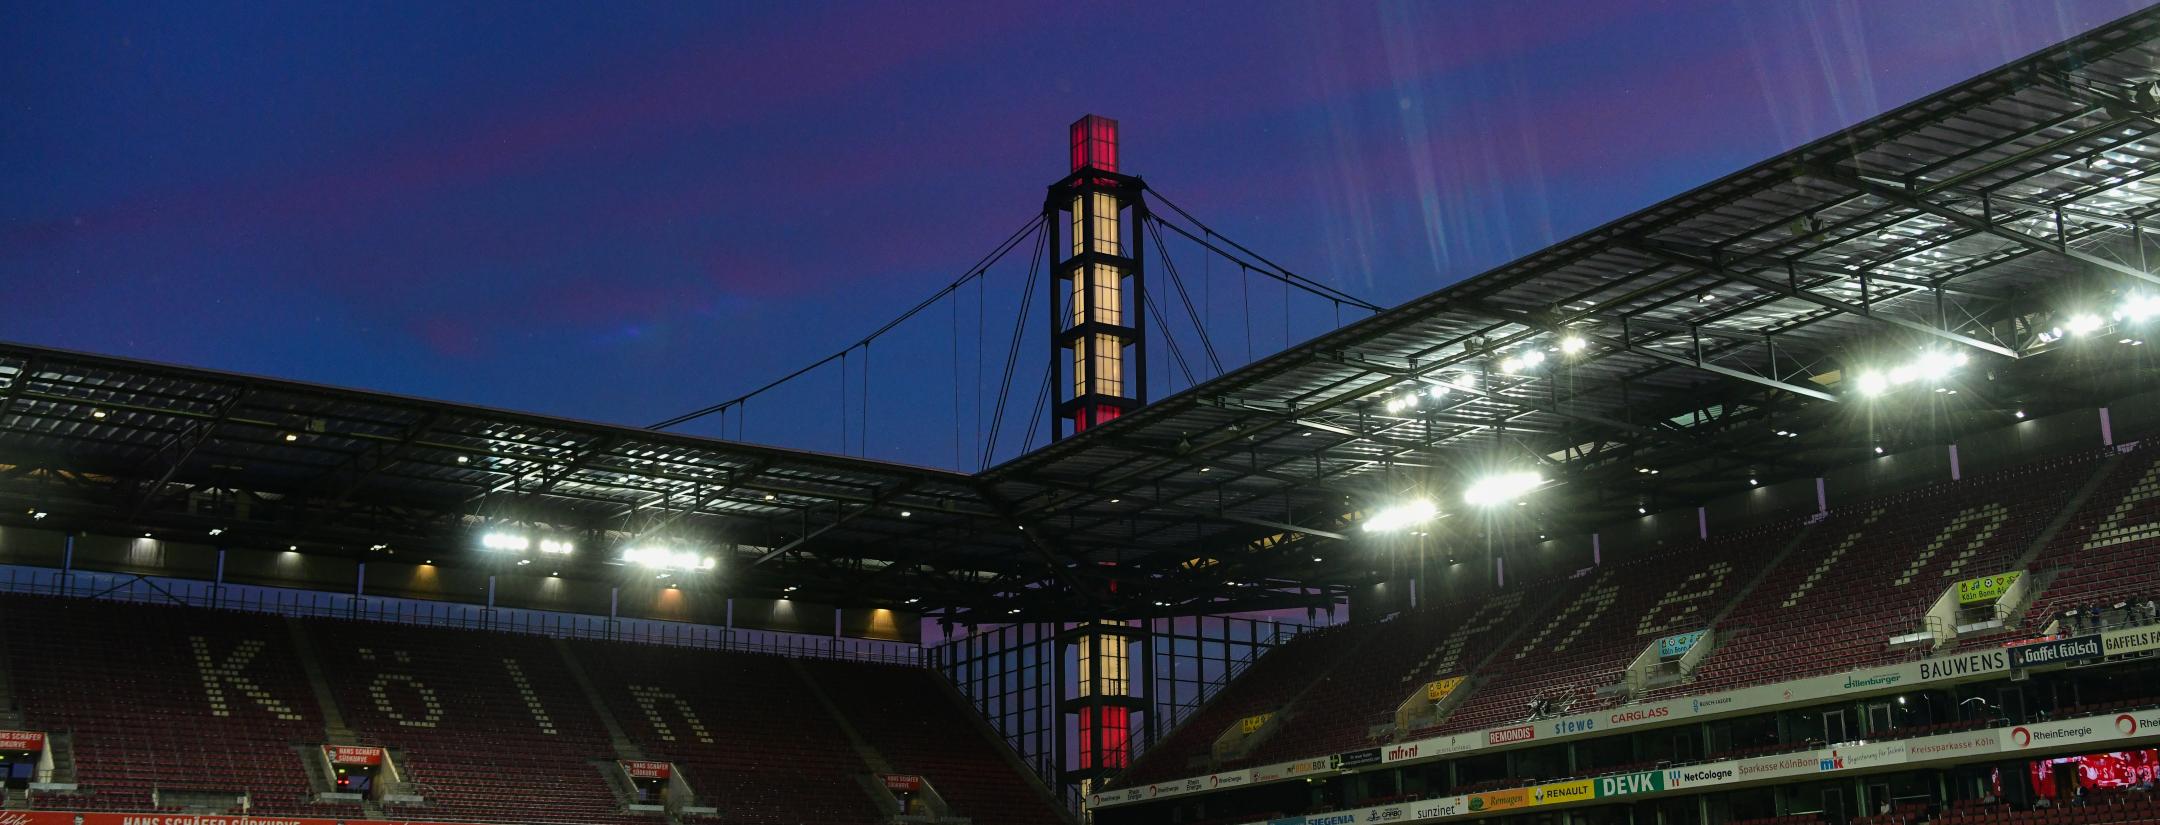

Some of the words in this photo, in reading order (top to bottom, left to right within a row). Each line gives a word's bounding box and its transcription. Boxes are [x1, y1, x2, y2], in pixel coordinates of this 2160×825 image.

[2106, 634, 2148, 650] GAFFELS
[2025, 643, 2059, 663] Gaffel
[2060, 639, 2098, 658] Kölsch
[1920, 653, 2004, 680] BAUWENS
[1611, 707, 1668, 724] CARGLASS
[1555, 719, 1593, 734] stewe
[2033, 726, 2092, 741] RheinEnergie
[1490, 727, 1531, 744] REMONDIS
[1911, 740, 1974, 754] Kreissparkasse
[1975, 737, 1994, 747] Köln
[1684, 768, 1732, 782] NetCologne
[1739, 762, 1777, 776] Sparkasse
[1779, 757, 1818, 769] KölnBonn
[1546, 785, 1589, 799] RENAULT
[1603, 773, 1655, 796] DEVK
[1418, 805, 1455, 819] sunzinet
